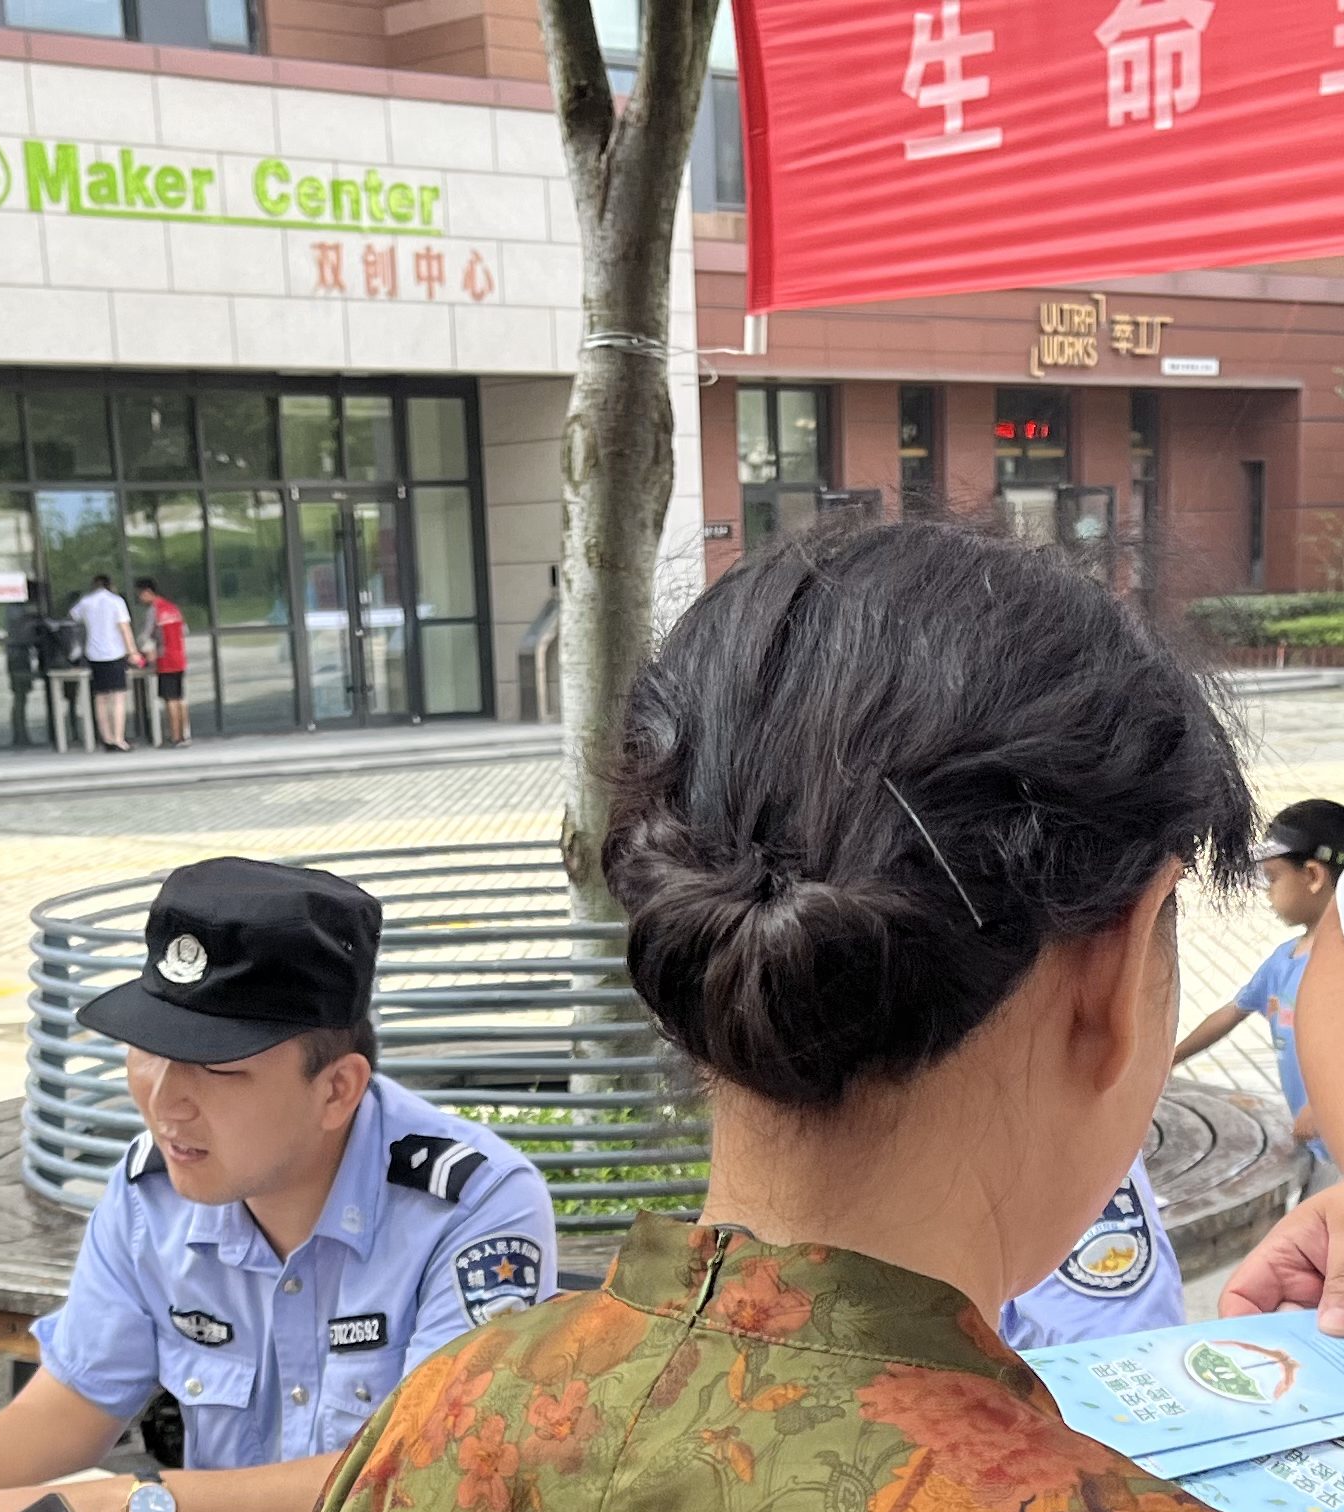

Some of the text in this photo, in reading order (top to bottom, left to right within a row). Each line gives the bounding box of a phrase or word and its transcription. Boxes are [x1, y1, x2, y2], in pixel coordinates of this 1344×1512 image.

[24, 139, 440, 225] Maker Center
[311, 241, 495, 303] 双创中心
[1040, 303, 1097, 334] ULTRA
[1040, 335, 1099, 367] WORKS
